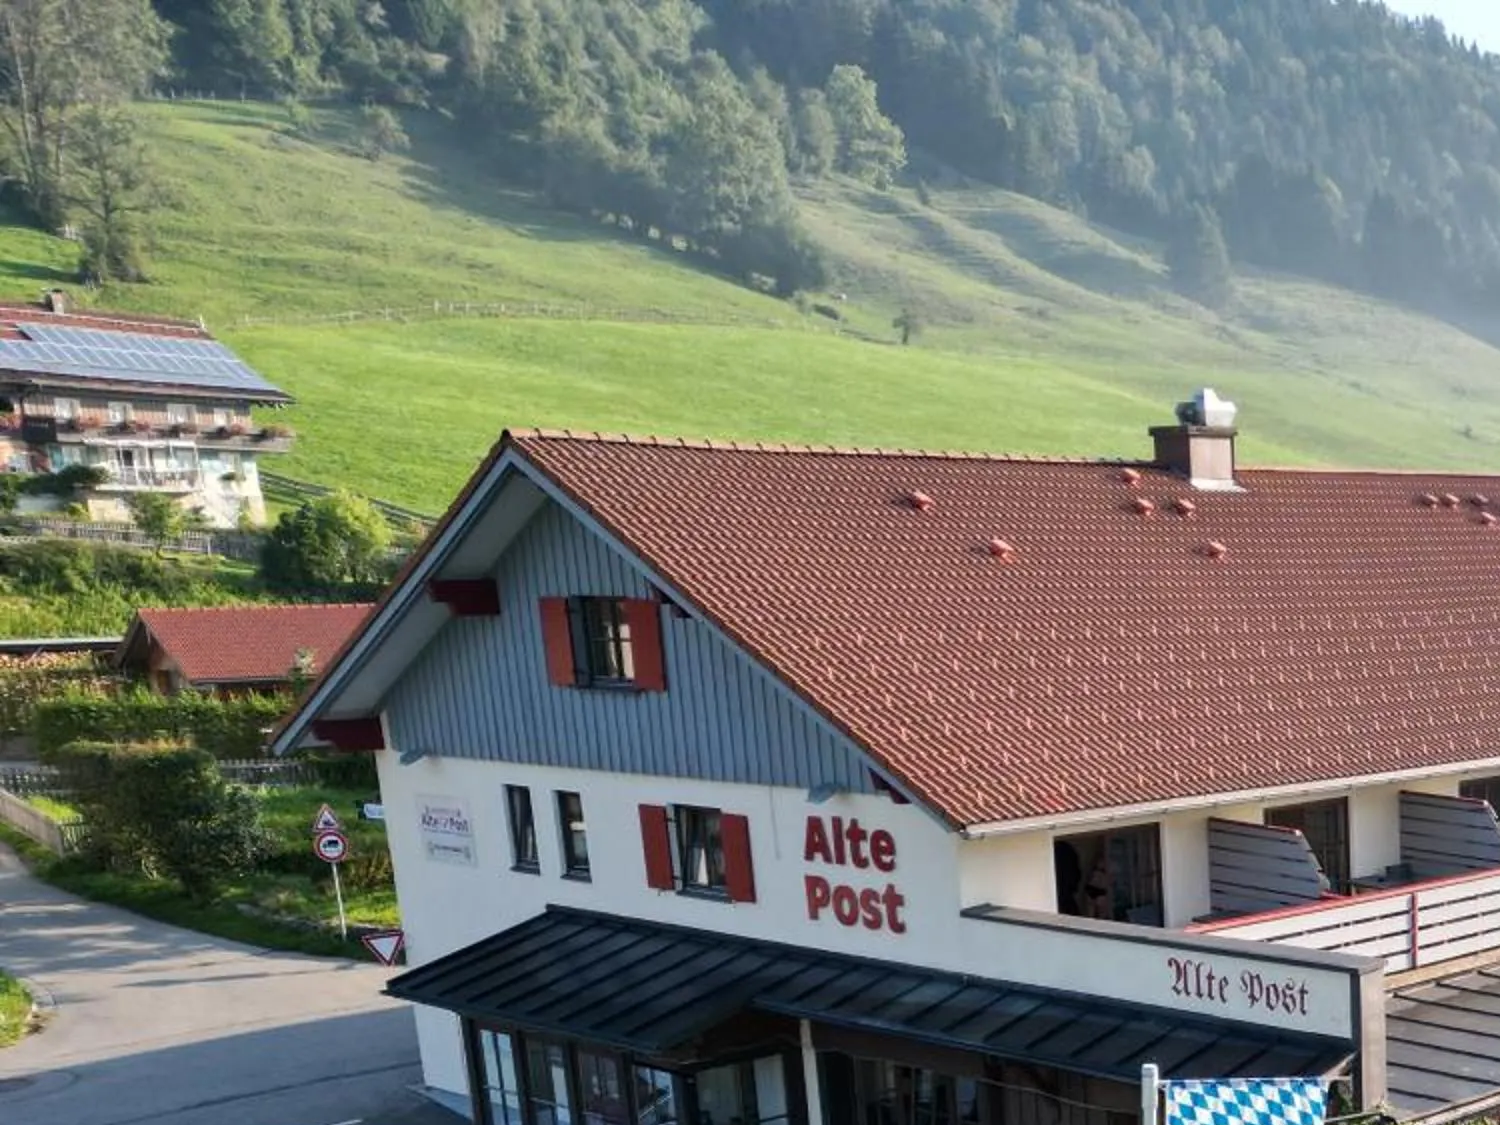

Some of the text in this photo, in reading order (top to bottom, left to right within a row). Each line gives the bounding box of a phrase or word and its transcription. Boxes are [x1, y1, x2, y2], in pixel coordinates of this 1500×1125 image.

[804, 815, 897, 872] Alte
[804, 875, 908, 934] Post
[1167, 957, 1309, 1016] Alte Post
